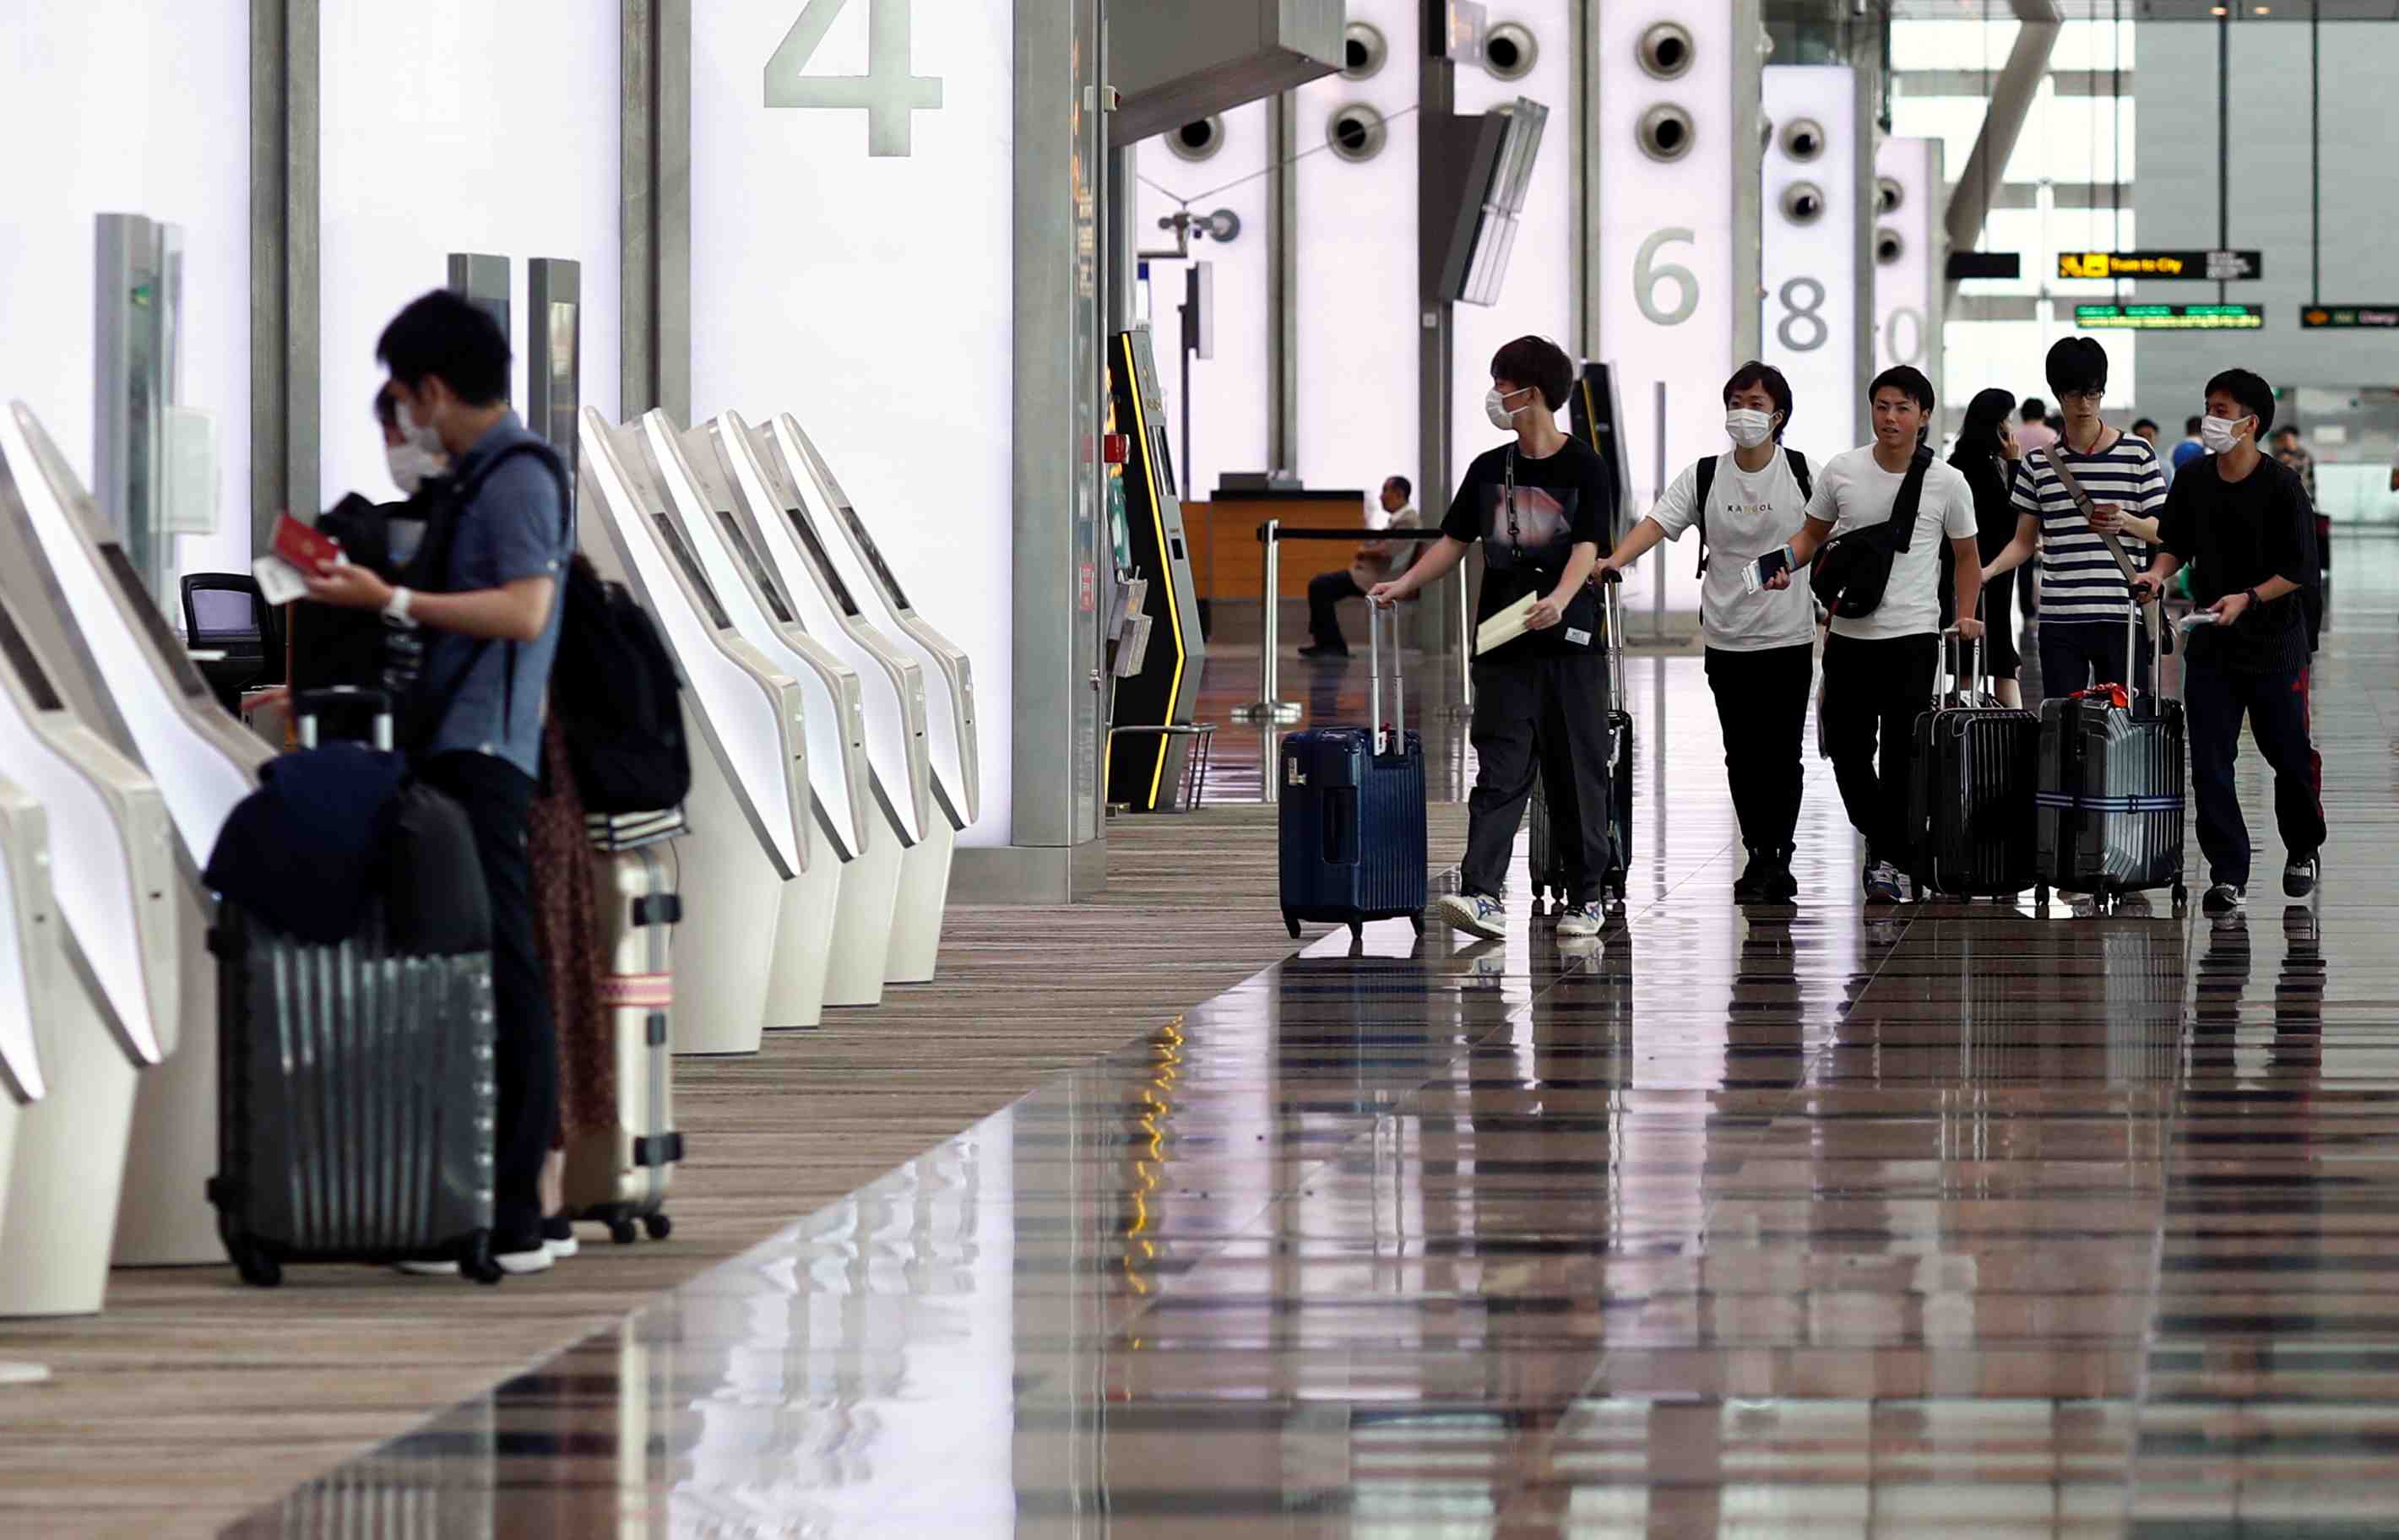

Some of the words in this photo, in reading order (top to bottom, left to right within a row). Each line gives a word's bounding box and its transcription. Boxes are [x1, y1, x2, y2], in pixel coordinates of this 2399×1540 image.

[763, 0, 943, 157] 4
[1633, 227, 1700, 327] 6
[1777, 276, 1828, 352] 8
